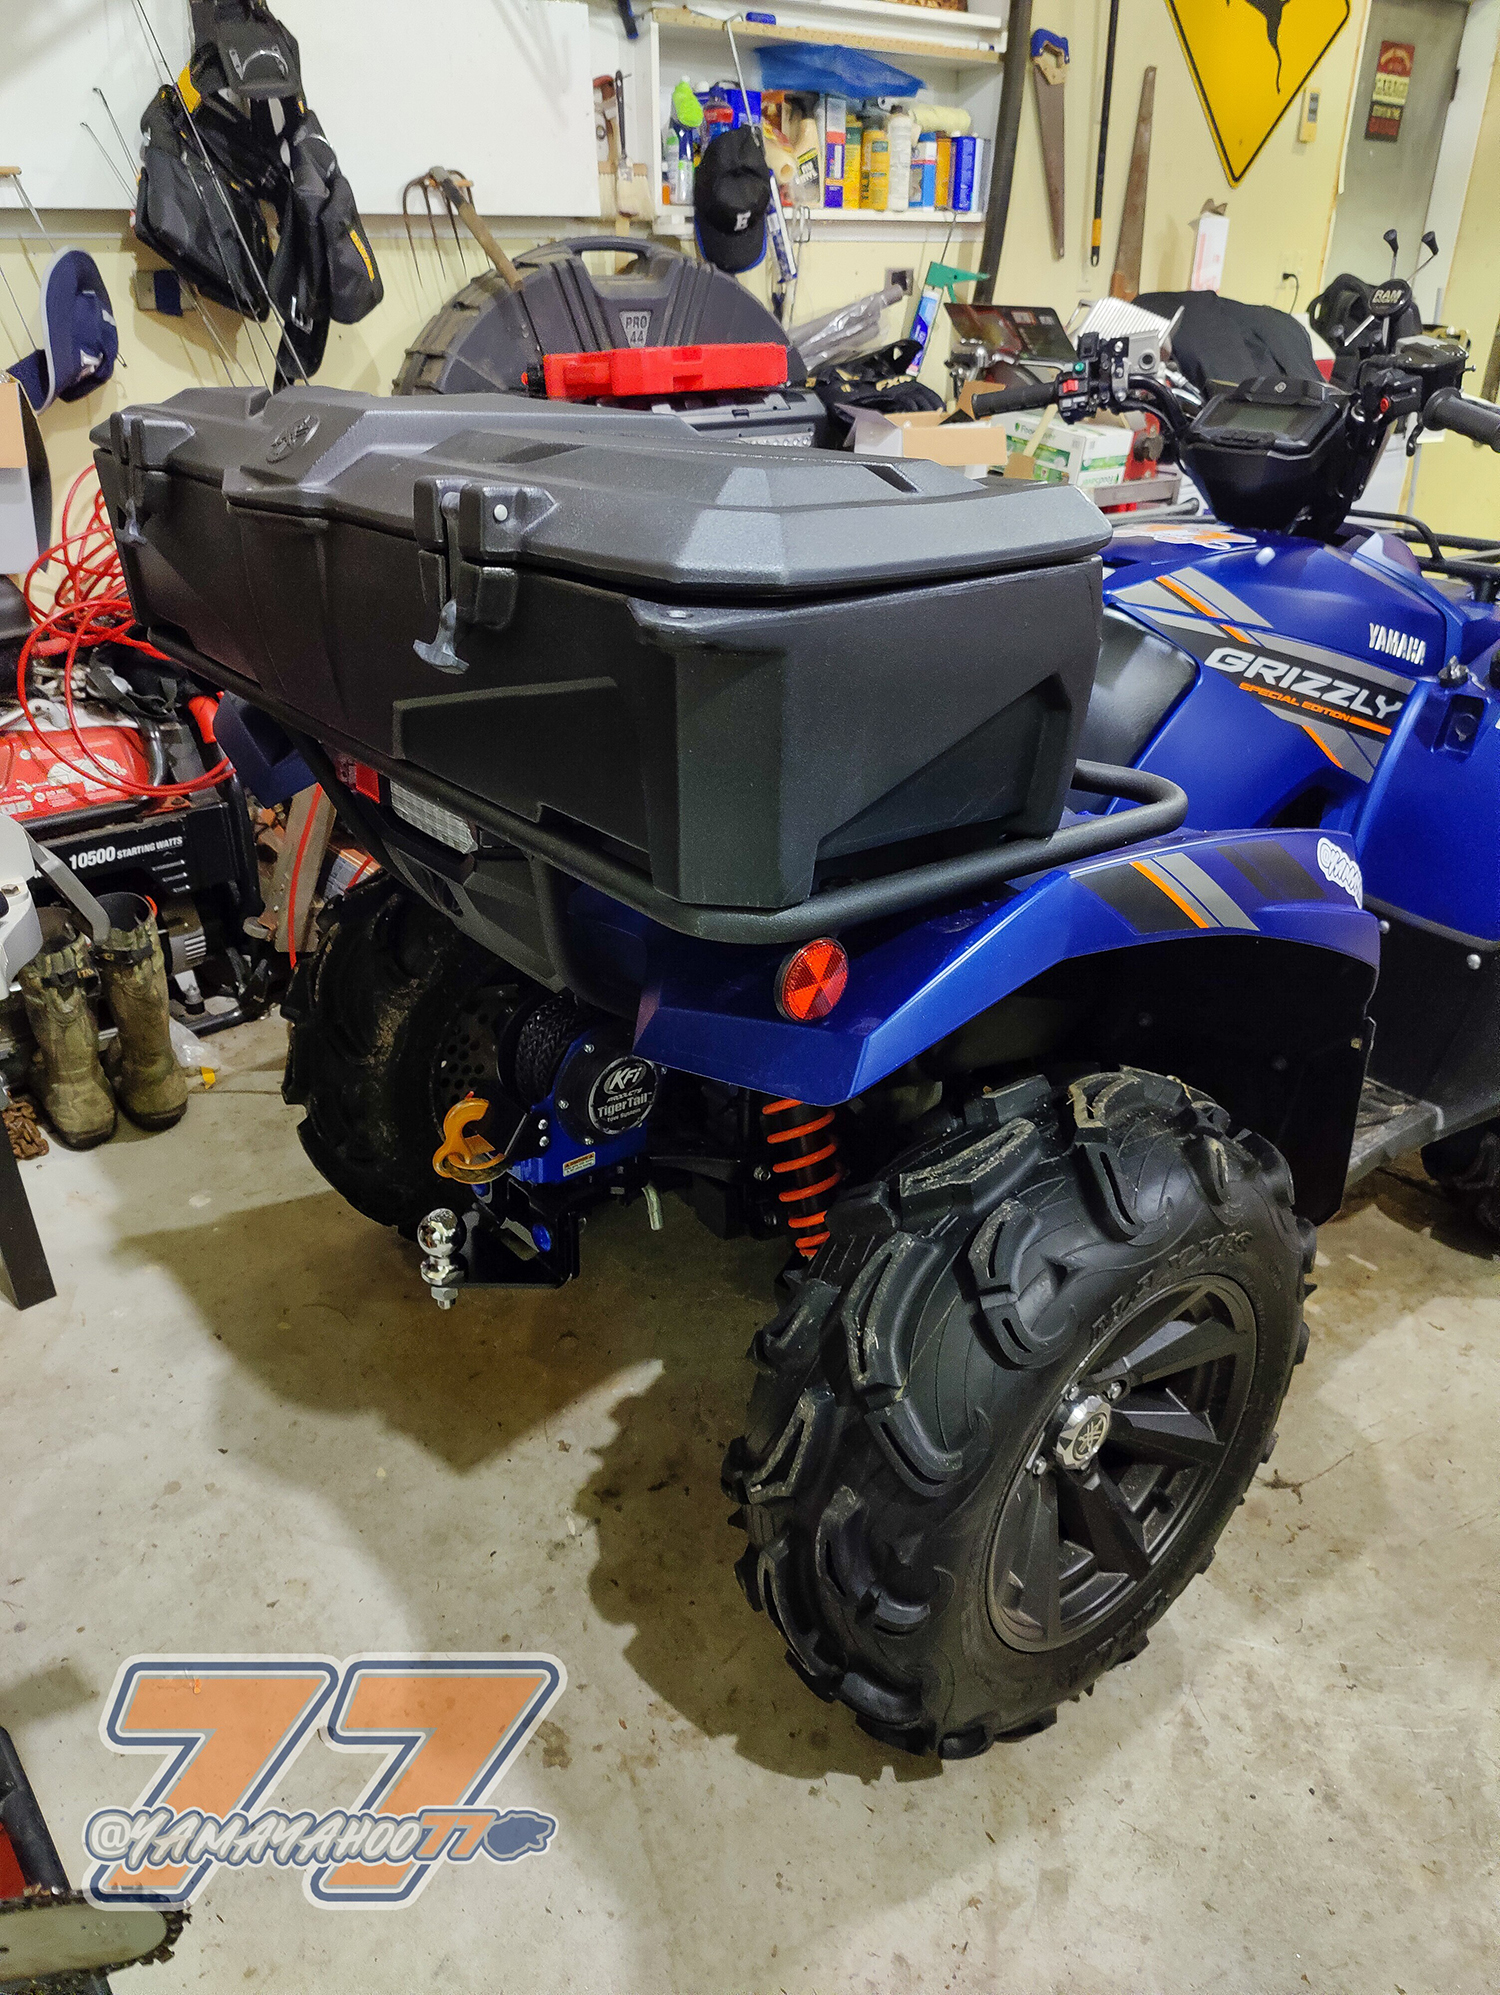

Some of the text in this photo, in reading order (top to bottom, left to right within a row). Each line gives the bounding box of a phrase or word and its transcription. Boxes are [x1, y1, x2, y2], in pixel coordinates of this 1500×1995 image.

[1371, 289, 1403, 304] RAM
[625, 315, 648, 329] PRO
[630, 330, 645, 344] 44
[1368, 622, 1427, 667] YAMAHA
[1203, 646, 1403, 720] GRIZZLY
[1238, 681, 1352, 723] SPECIAL EDITION
[69, 836, 183, 870] 10500 STARTING WATTS
